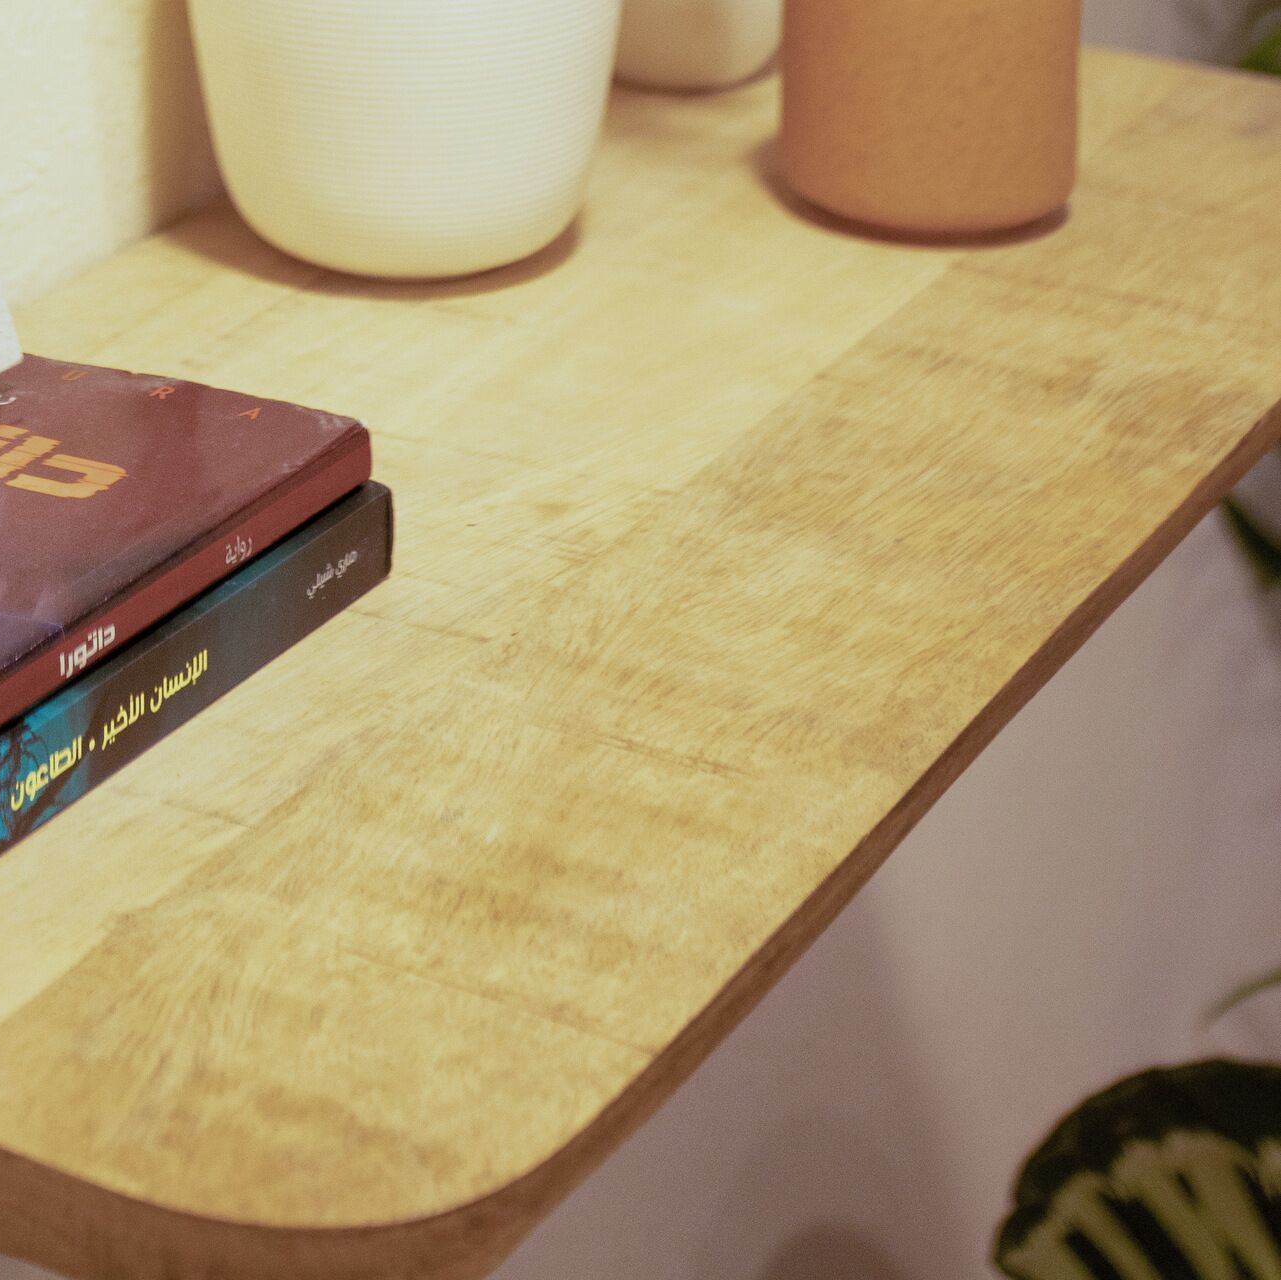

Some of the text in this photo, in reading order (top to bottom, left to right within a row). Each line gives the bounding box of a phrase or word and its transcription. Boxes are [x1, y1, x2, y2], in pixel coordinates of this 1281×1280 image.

[225, 536, 254, 565] رواية
[59, 623, 116, 678] داتورا
[11, 649, 208, 811] الإنسان الأخير الطاعون
